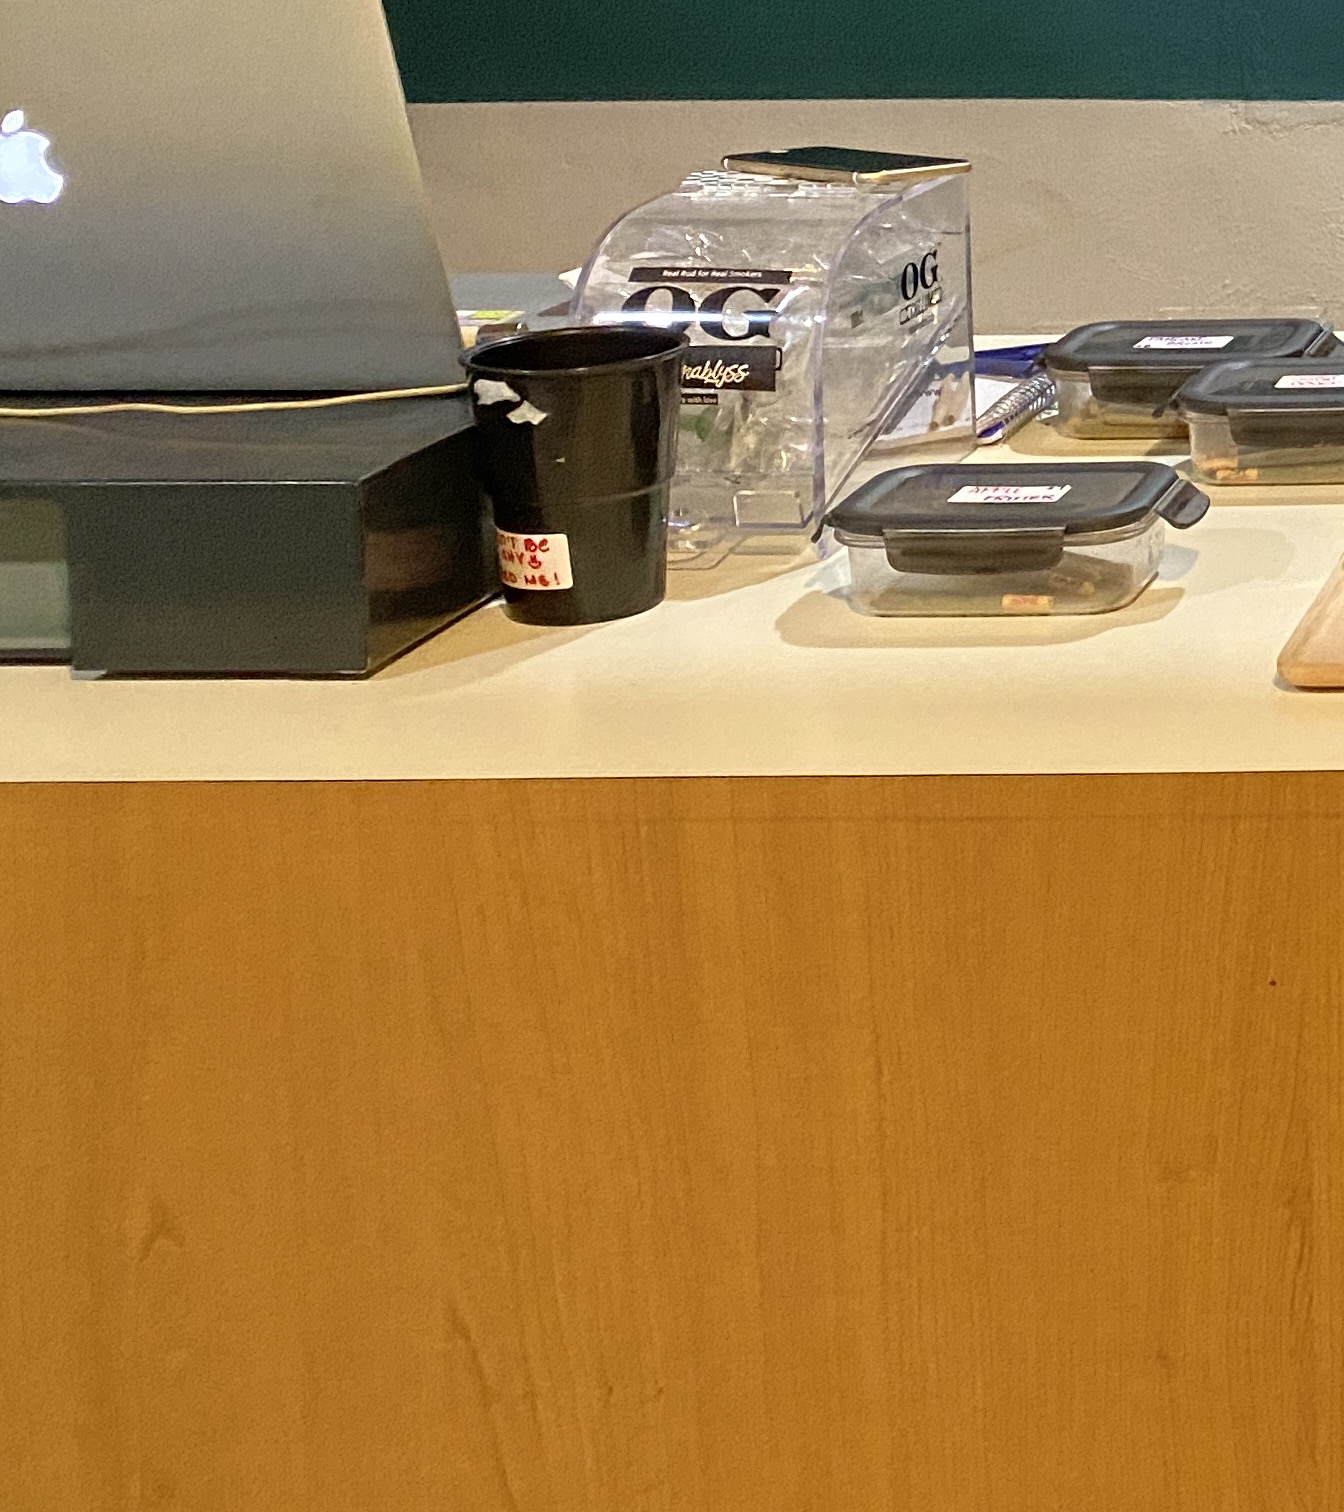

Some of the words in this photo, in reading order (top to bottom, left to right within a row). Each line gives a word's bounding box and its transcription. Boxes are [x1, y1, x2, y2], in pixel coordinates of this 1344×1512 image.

[697, 270, 709, 278] for
[729, 271, 763, 280] Smokers
[901, 250, 939, 301] OG
[621, 286, 780, 340] OG
[682, 359, 750, 388] nablyss
